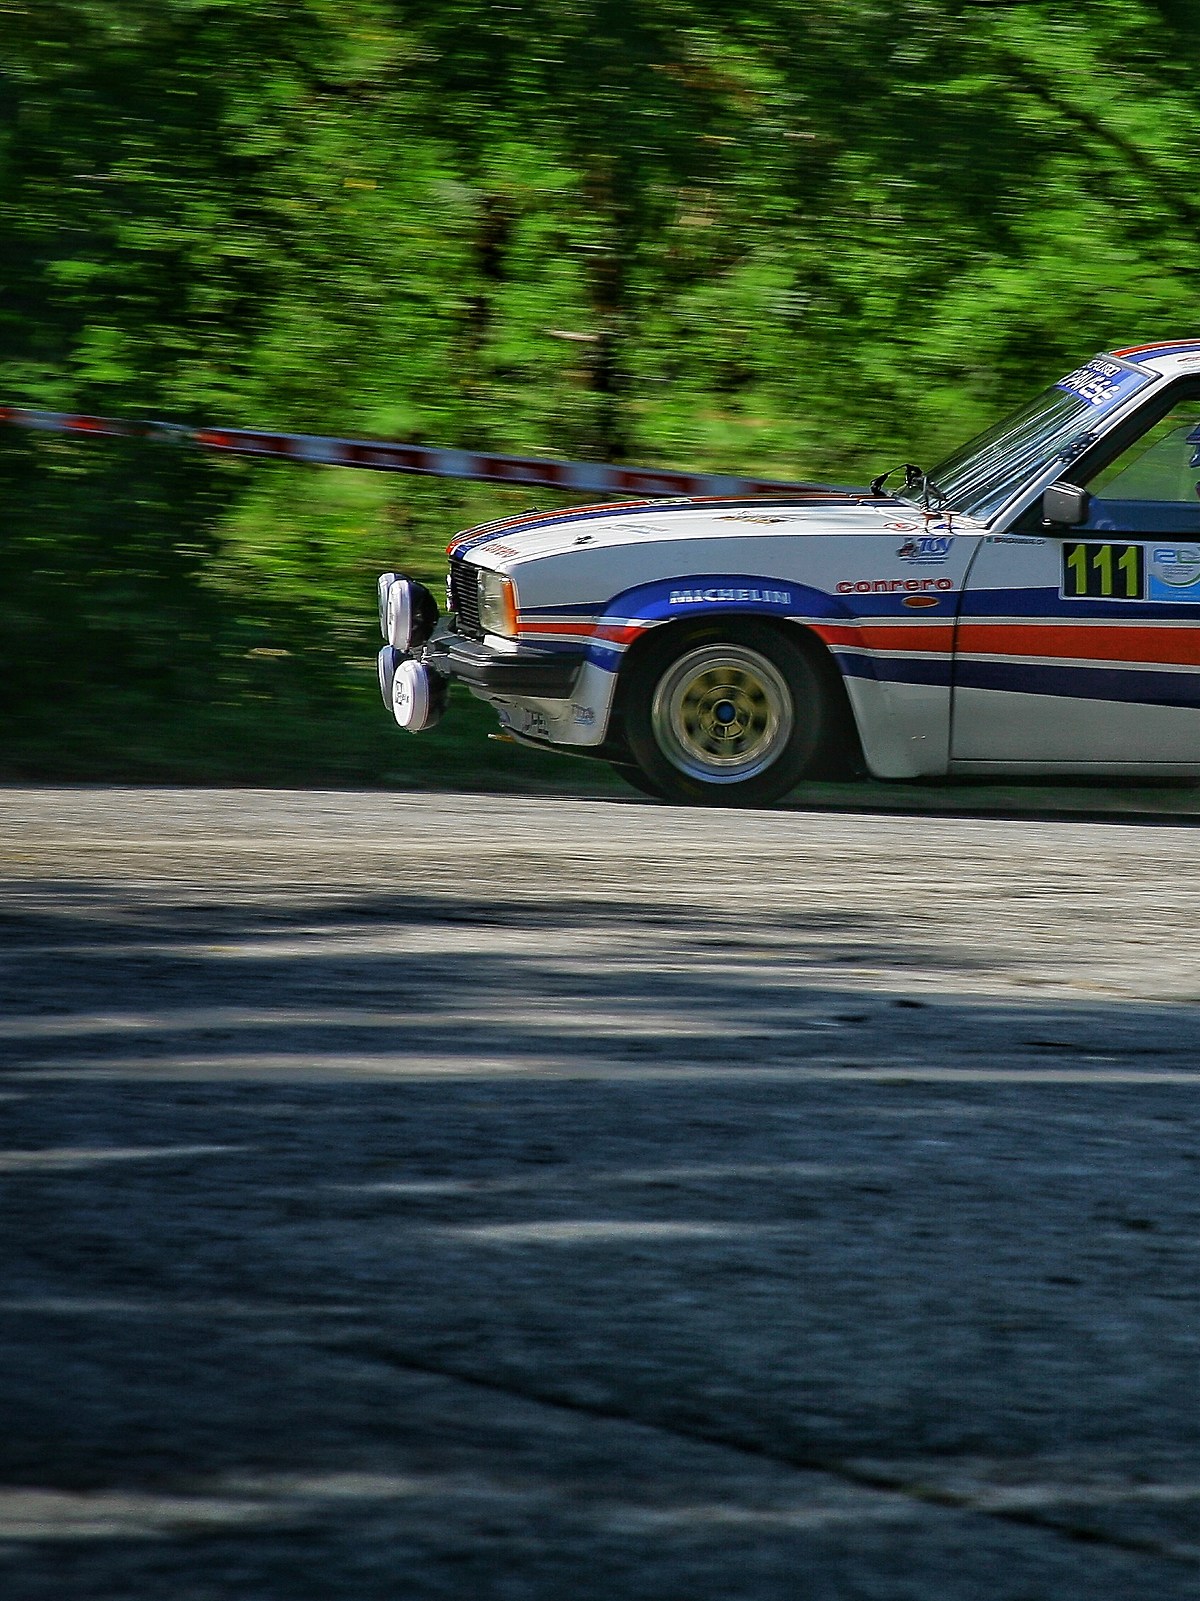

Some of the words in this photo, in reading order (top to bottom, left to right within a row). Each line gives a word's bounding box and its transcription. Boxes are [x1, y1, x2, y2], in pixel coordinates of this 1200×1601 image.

[1067, 544, 1138, 597] 111
[836, 577, 954, 594] conrero
[669, 588, 791, 605] MICHELIN
